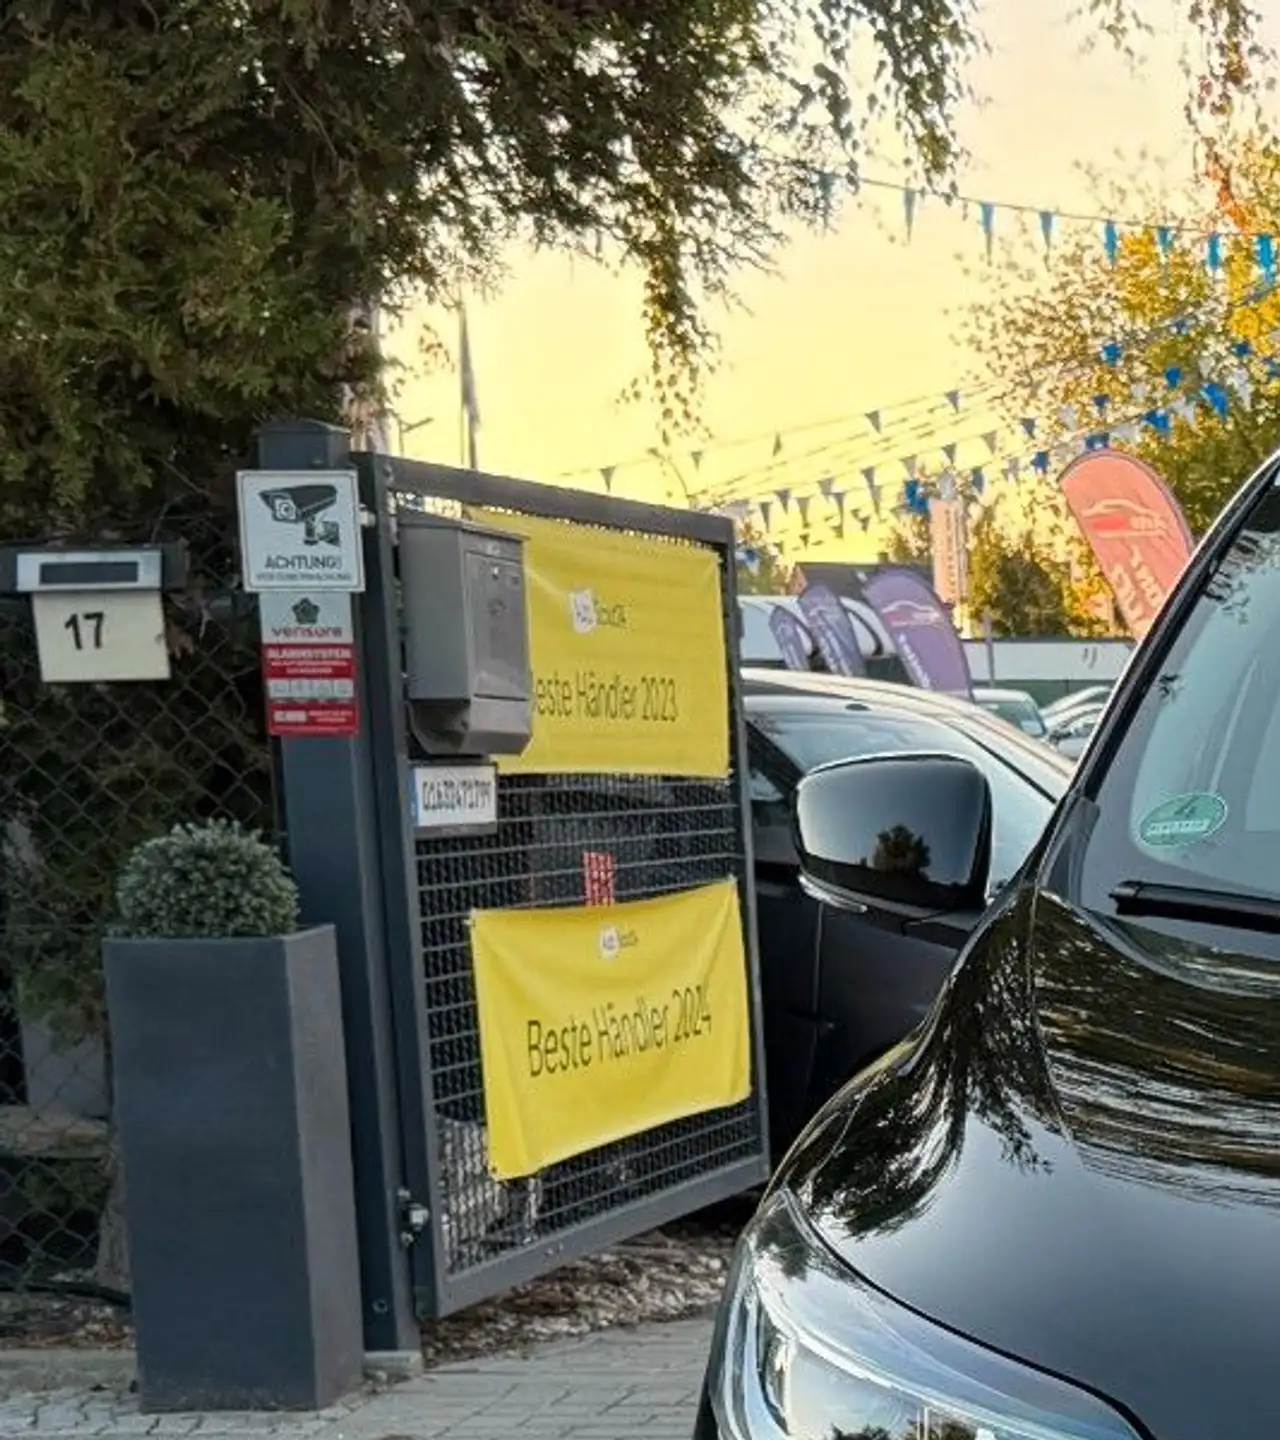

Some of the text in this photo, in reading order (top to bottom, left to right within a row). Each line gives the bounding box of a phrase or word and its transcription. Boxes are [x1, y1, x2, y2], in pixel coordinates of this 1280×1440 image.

[64, 611, 104, 650] 17
[534, 670, 679, 722] este Händler 2023
[527, 985, 712, 1077] Beste Händler 2024
